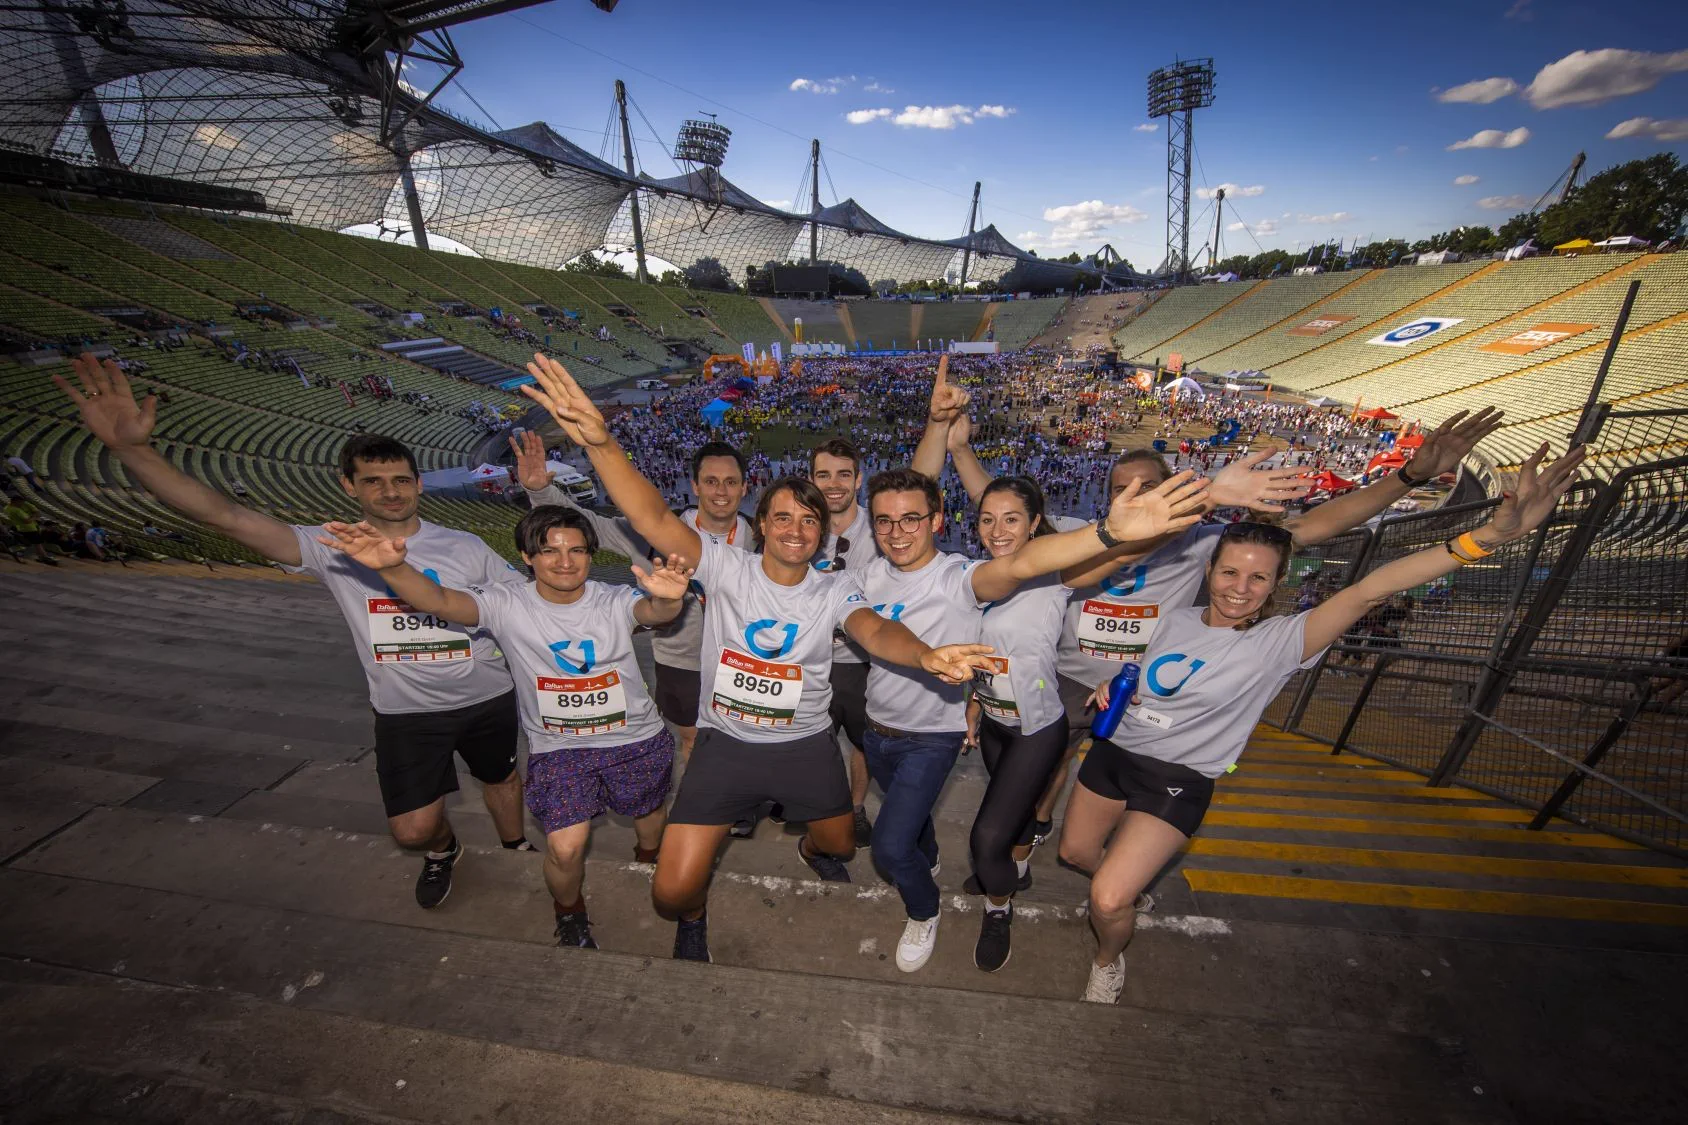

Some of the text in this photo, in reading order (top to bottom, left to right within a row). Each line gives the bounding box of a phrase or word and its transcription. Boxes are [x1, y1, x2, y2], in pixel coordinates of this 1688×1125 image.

[1095, 617, 1141, 634] 8945
[733, 672, 783, 696] 8950
[557, 691, 609, 708] 8949
